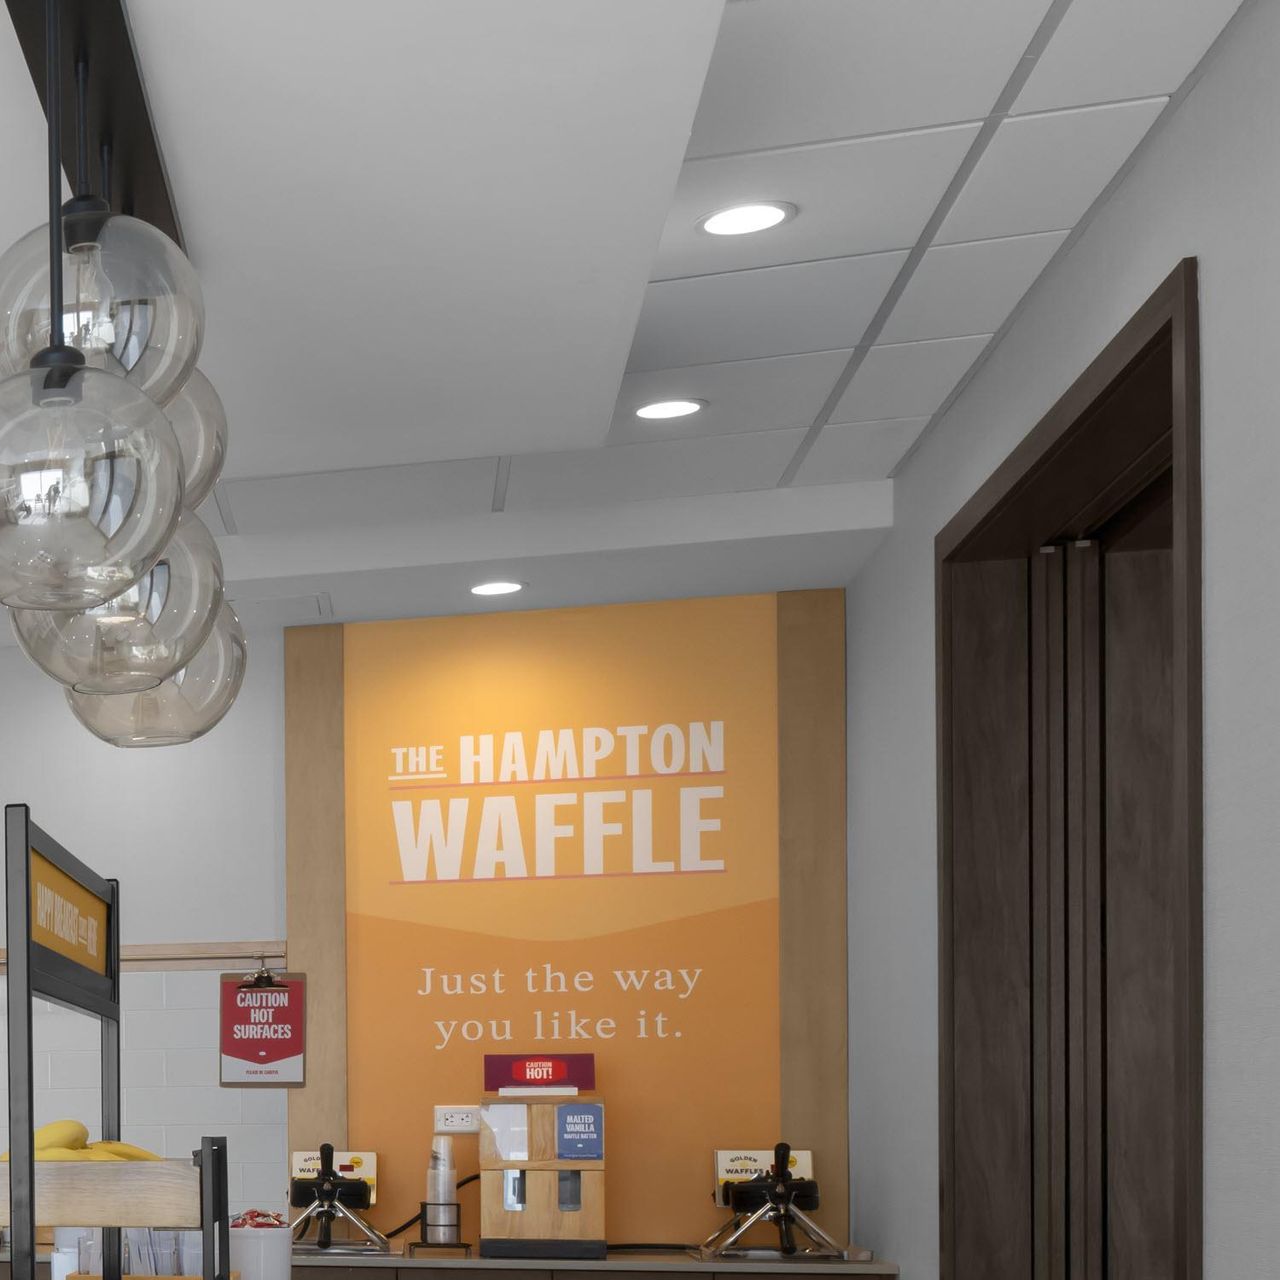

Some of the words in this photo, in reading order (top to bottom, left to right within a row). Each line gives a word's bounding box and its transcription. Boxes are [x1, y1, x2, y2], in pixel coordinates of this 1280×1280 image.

[391, 745, 444, 773] THE
[459, 721, 724, 784] HAMPTON
[391, 786, 725, 882] WAFFLE
[418, 964, 506, 996] Just
[525, 964, 595, 993] the
[613, 967, 703, 999] way
[236, 992, 289, 1007] CAUTION
[250, 1008, 274, 1023] HOT
[233, 1024, 292, 1039] SURFACES
[434, 1017, 513, 1051] you
[533, 1010, 617, 1041] like
[636, 1010, 683, 1039] it.
[526, 1068, 552, 1080] HOT!
[566, 1115, 594, 1123] MALTED
[565, 1123, 595, 1132] VANILLA
